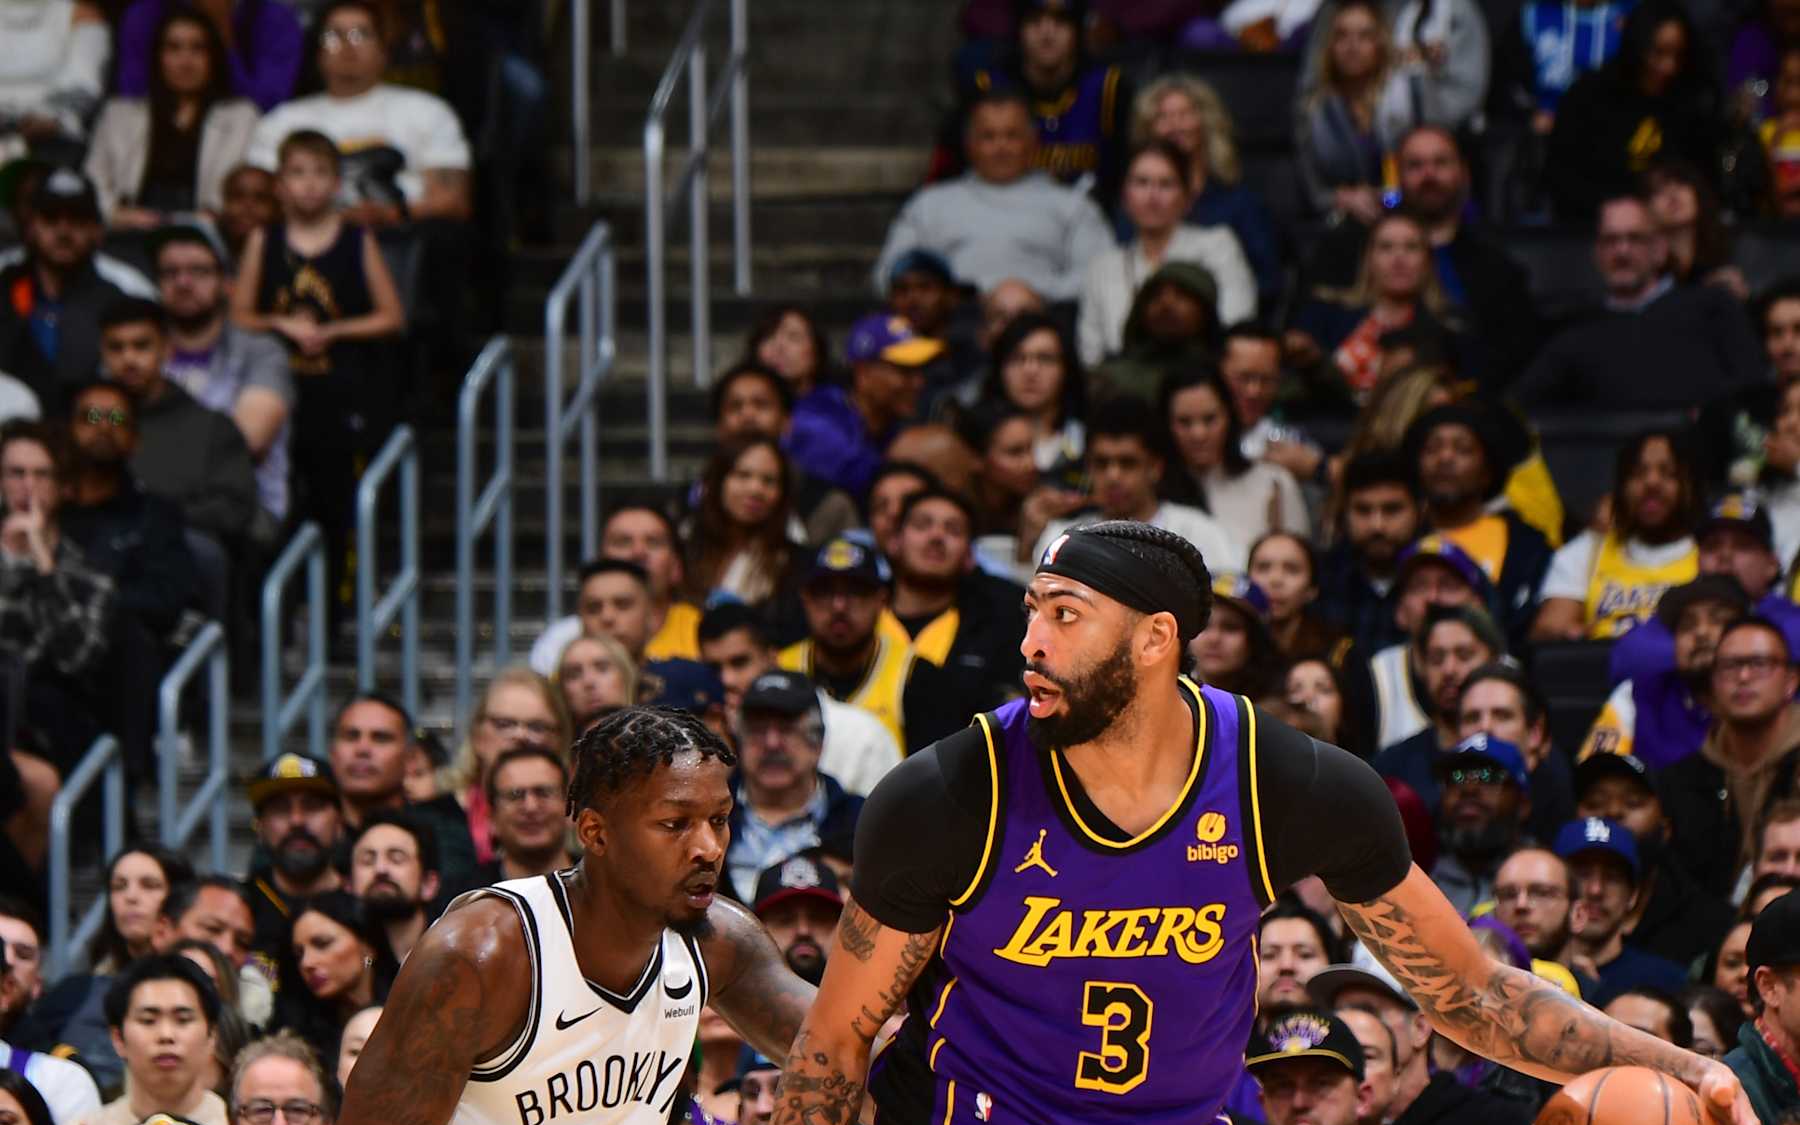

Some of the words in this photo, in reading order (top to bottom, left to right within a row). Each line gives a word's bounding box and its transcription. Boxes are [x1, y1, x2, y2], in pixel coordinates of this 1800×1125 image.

[1187, 843, 1238, 864] bibigo
[993, 897, 1226, 967] LAKERS
[664, 1005, 695, 1019] Webull
[1075, 981, 1153, 1095] 3
